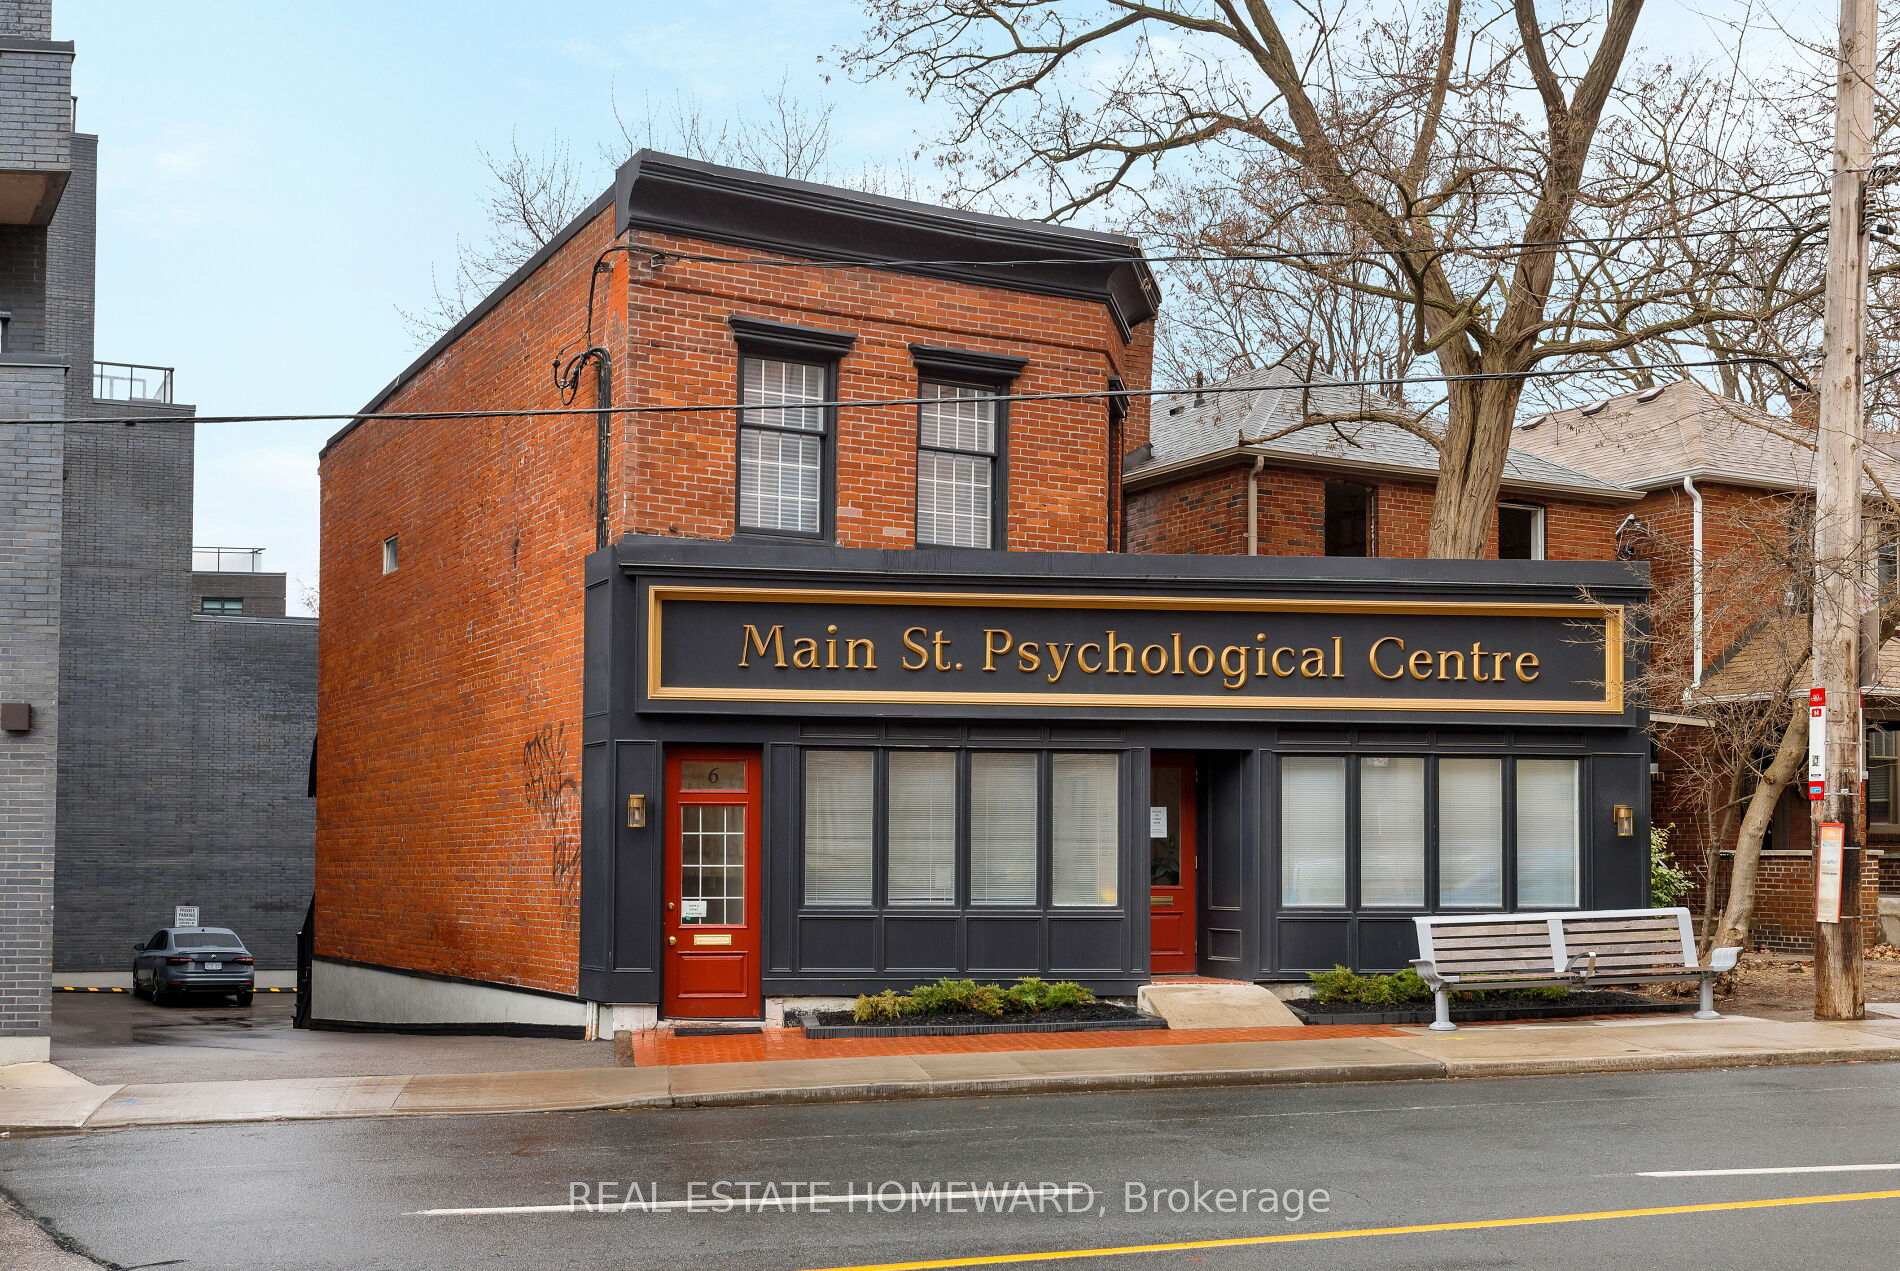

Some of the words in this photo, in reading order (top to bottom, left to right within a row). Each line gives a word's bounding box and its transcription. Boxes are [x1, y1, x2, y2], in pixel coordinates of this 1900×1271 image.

[738, 624, 878, 670] Main
[902, 626, 964, 672] St.
[982, 628, 1345, 690] Psychological
[1369, 636, 1541, 683] Centre
[708, 767, 720, 784] 6
